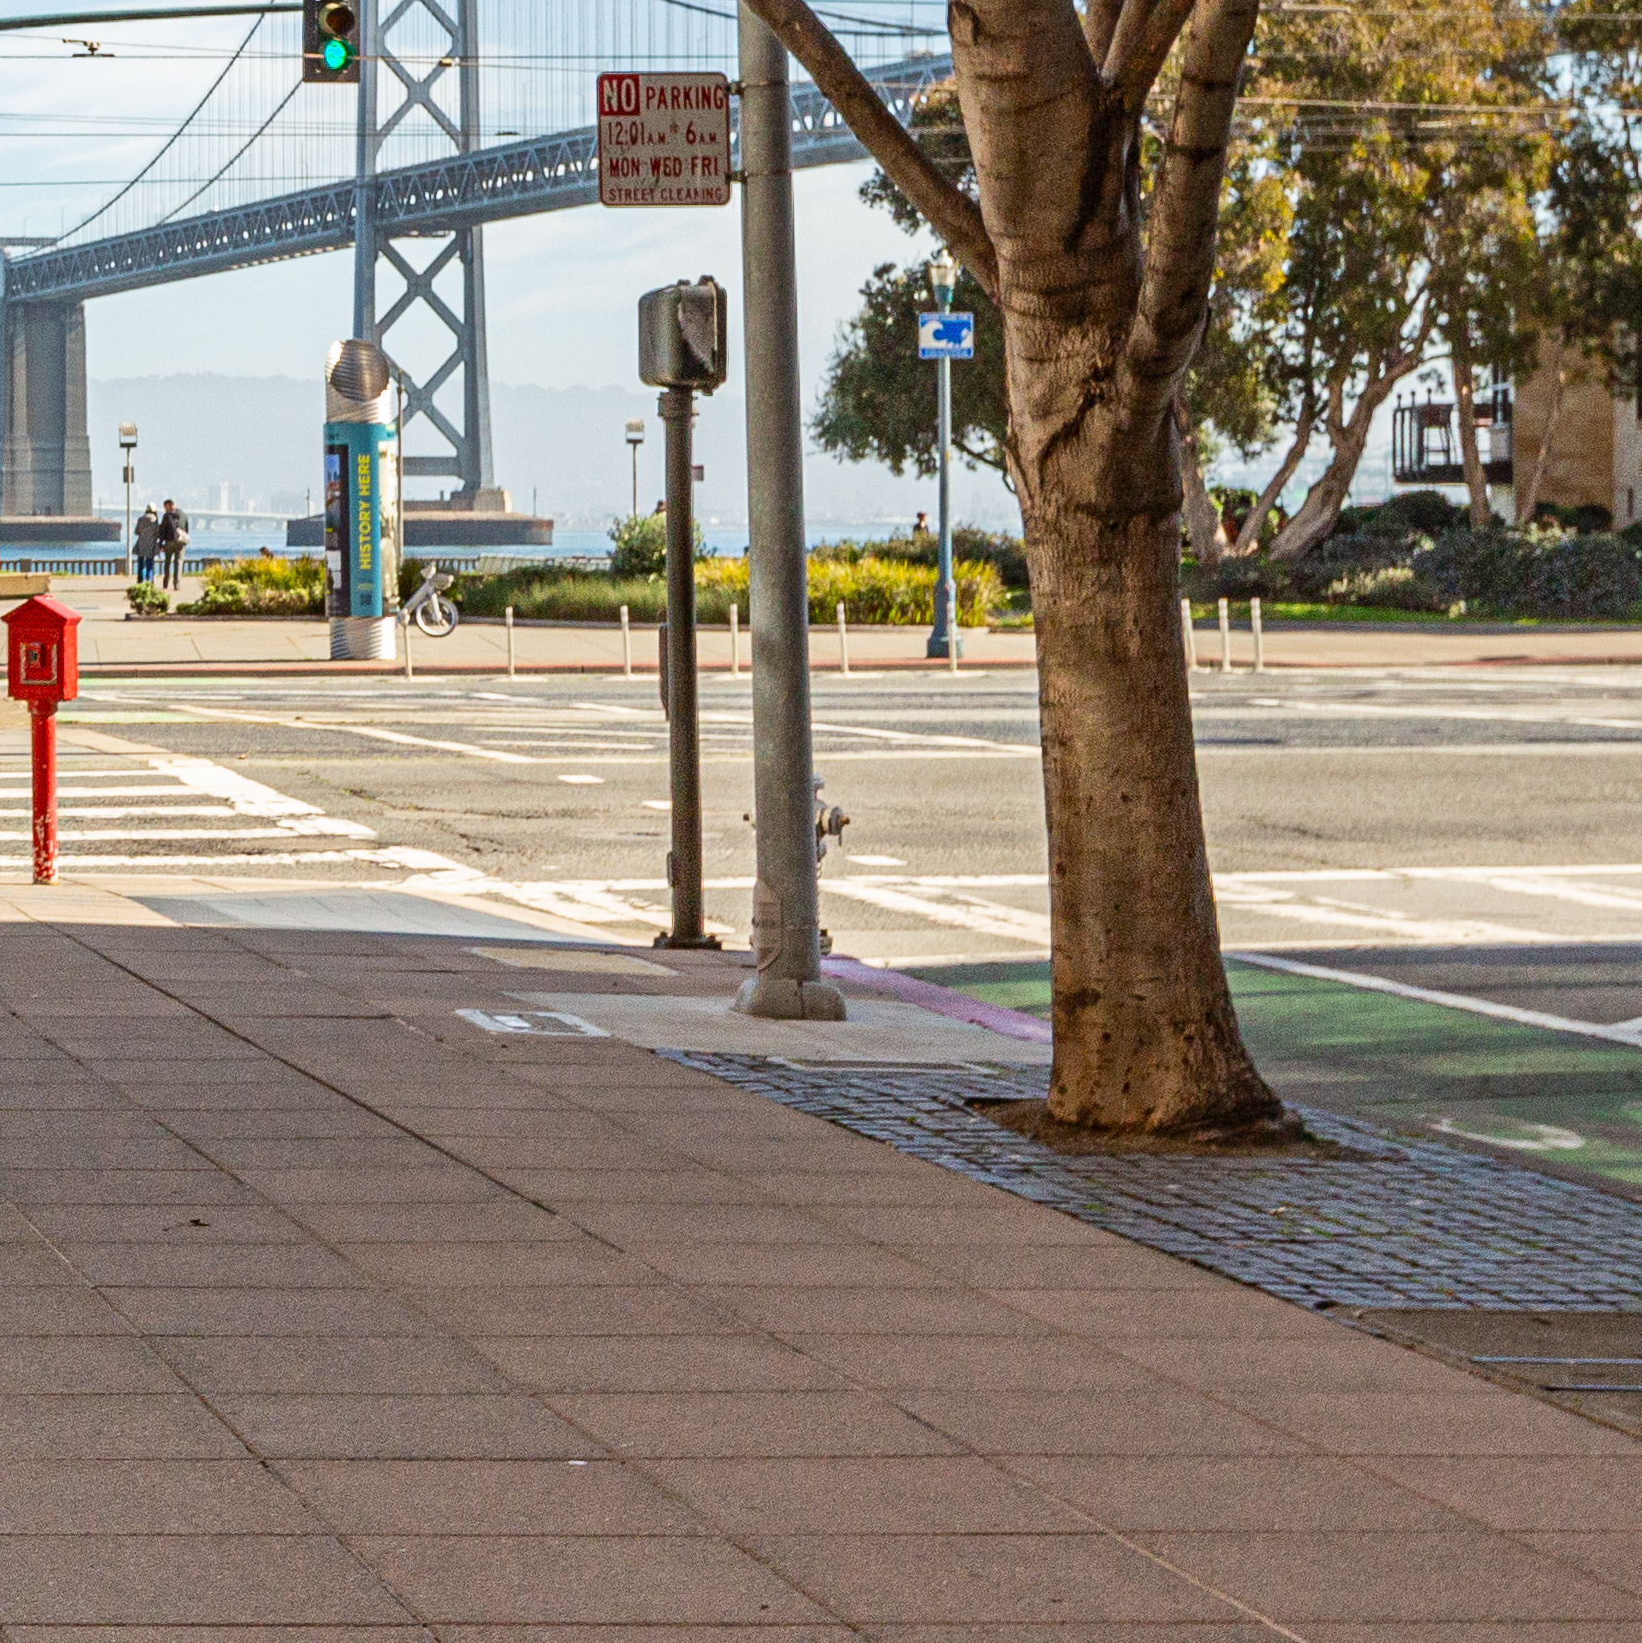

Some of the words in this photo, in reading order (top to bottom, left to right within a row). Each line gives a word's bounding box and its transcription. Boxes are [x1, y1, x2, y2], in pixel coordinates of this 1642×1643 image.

[603, 78, 635, 112] NO
[645, 85, 724, 110] PARKING
[609, 157, 640, 177] MON
[650, 156, 682, 177] WED
[690, 156, 718, 176] FRI
[609, 187, 655, 201] STREET
[660, 187, 723, 201] CLEANING
[358, 454, 371, 496] HERE
[358, 501, 372, 570] HISTORY
